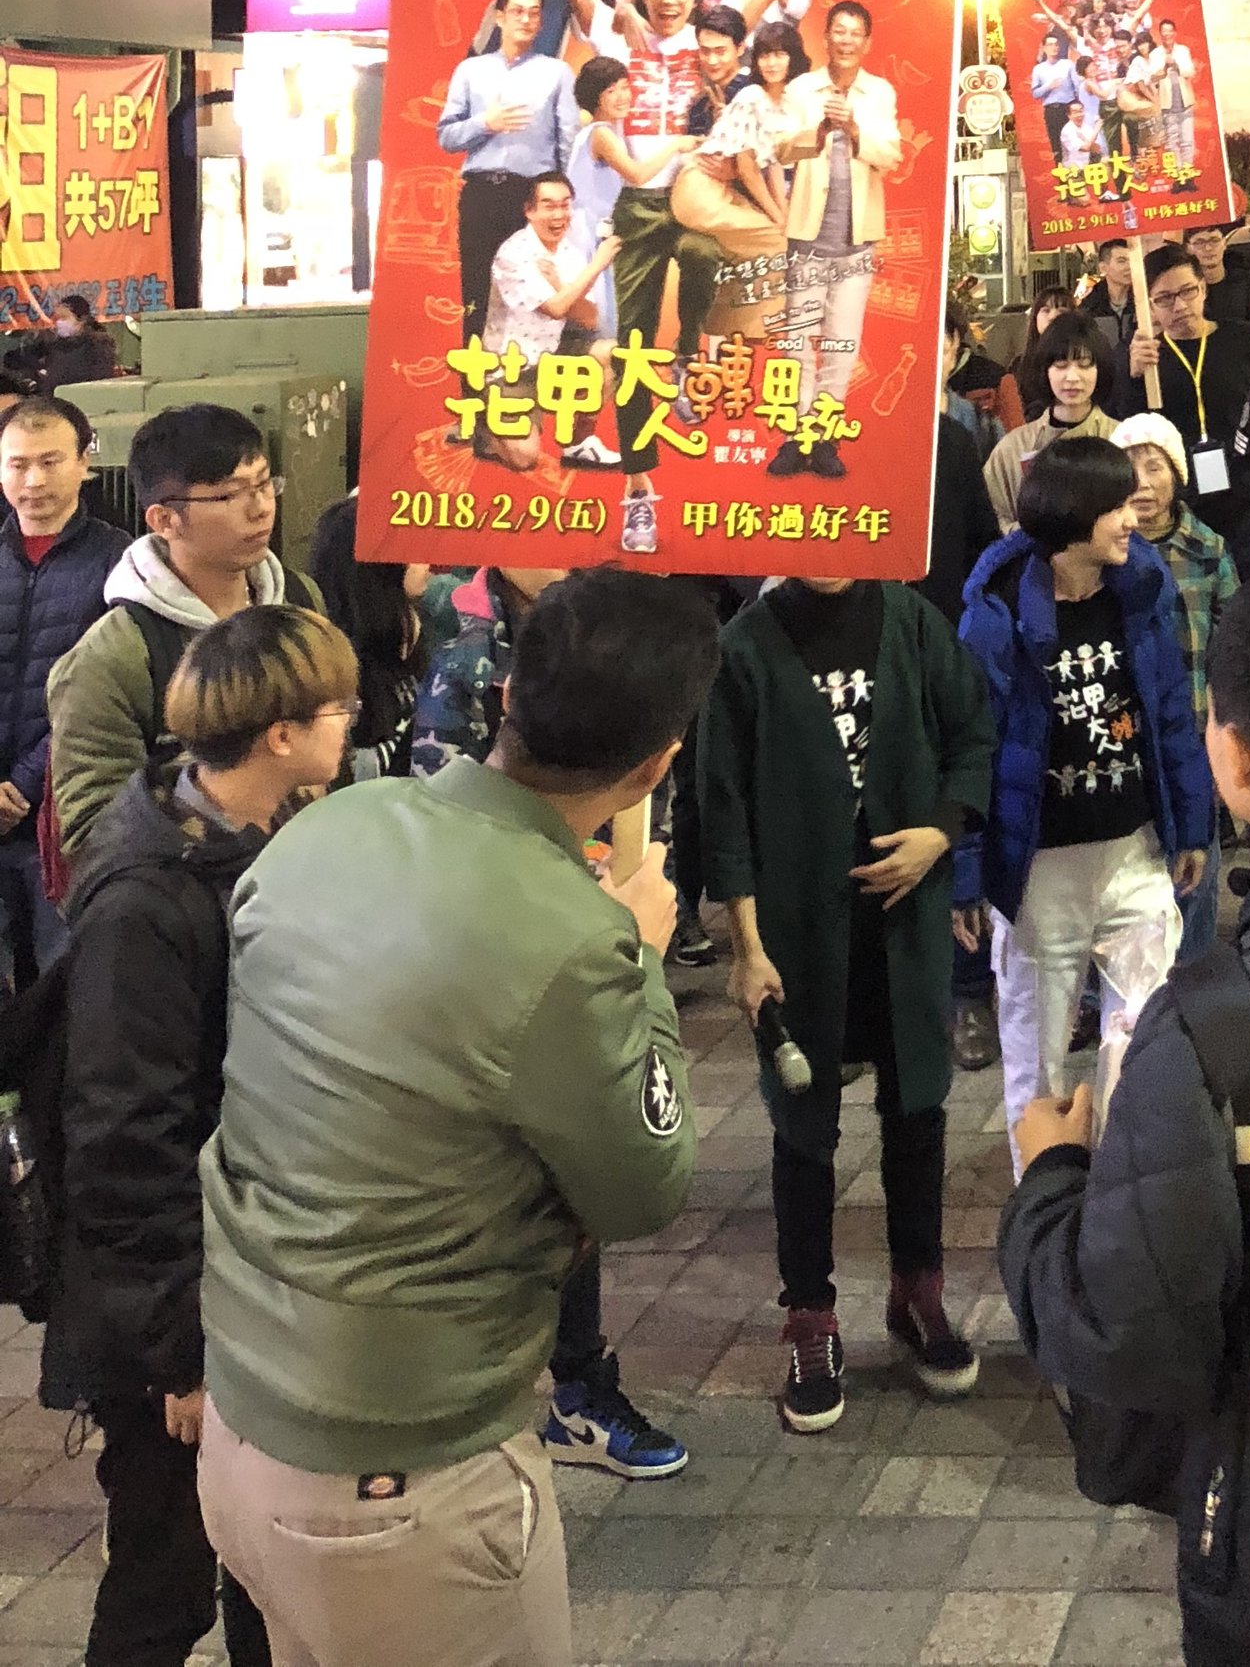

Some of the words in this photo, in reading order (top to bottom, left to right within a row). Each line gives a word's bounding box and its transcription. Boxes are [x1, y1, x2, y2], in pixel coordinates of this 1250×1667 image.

[71, 92, 154, 151] 1+B1
[64, 169, 160, 238] 共57坪
[765, 334, 804, 352] Good
[809, 335, 856, 353] Times
[727, 429, 756, 444] 導演
[390, 489, 607, 534] 2018/2/9(五)
[682, 500, 892, 542] 甲你過好年
